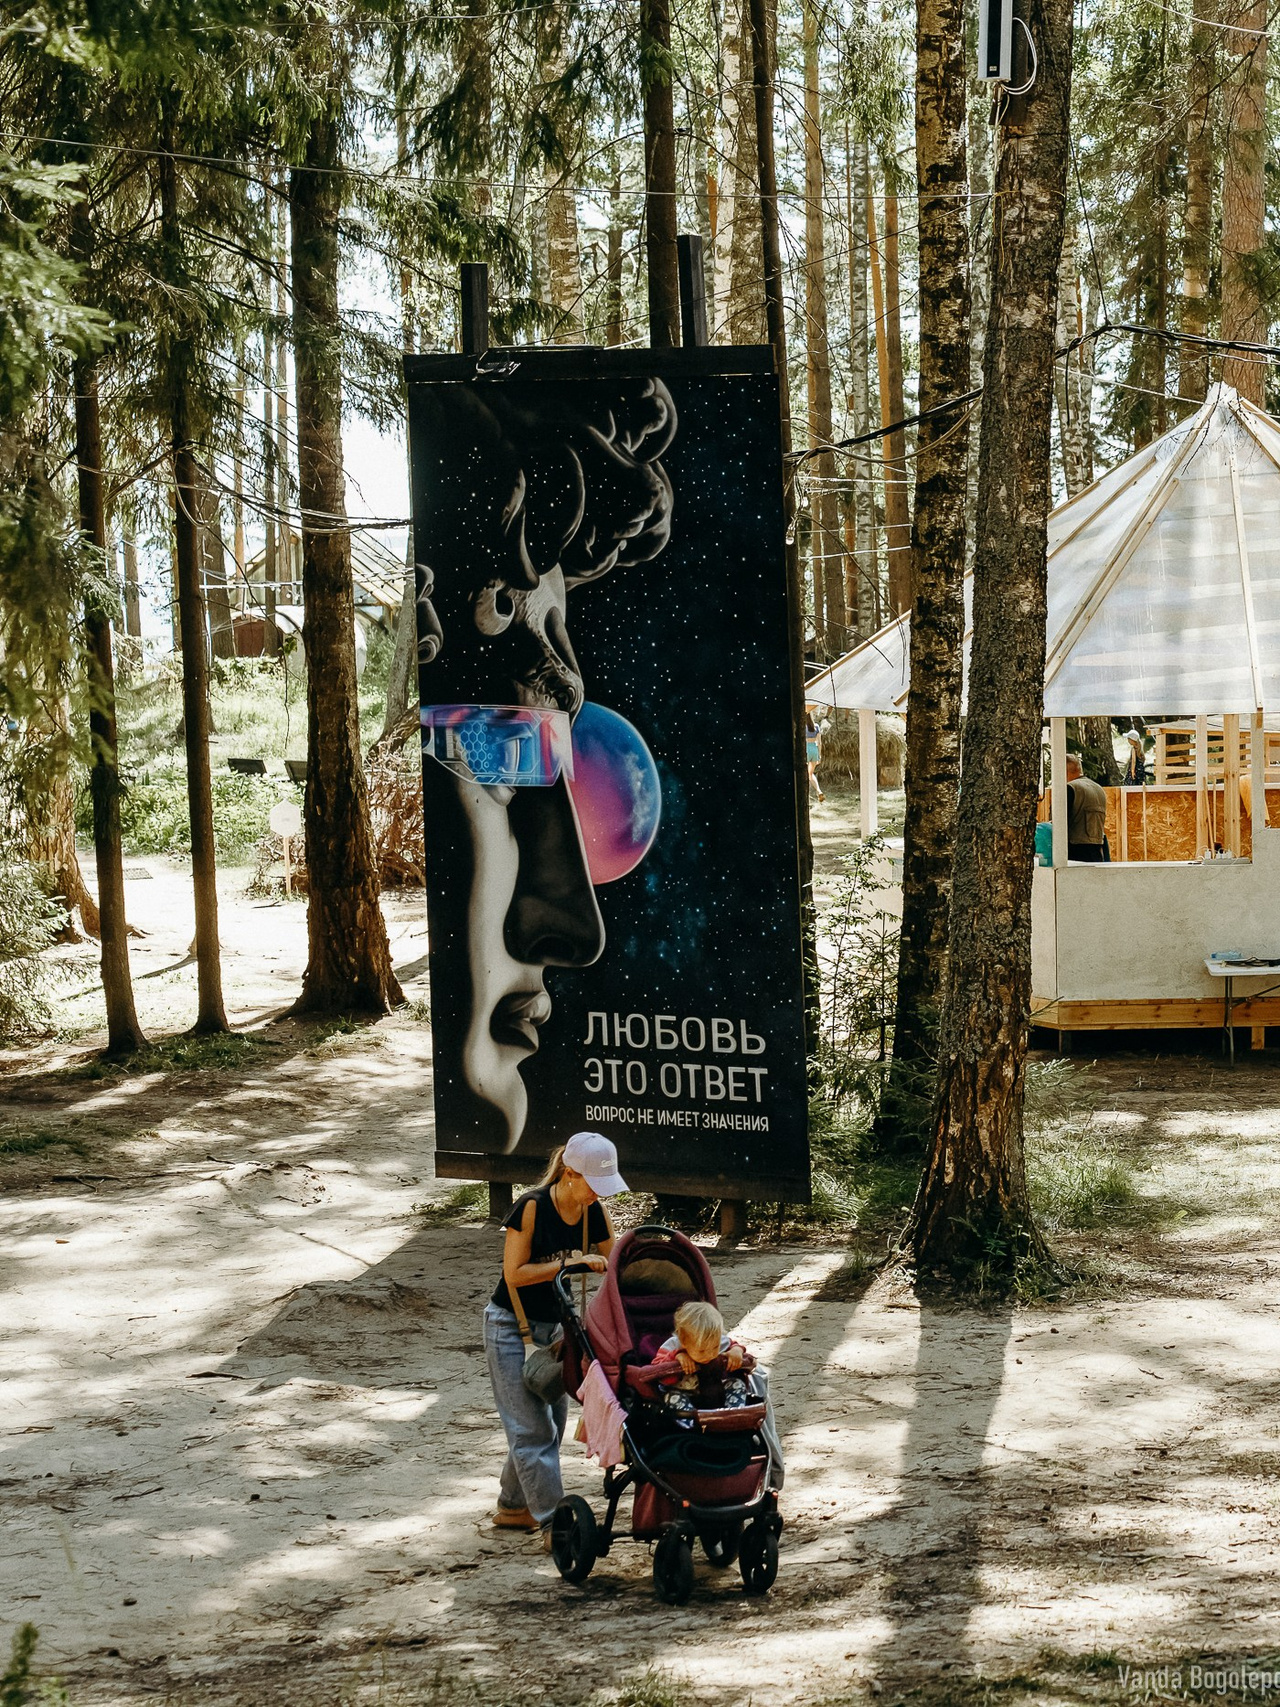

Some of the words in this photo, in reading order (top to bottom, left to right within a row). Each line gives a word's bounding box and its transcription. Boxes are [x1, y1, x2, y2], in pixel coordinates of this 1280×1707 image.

[583, 1011, 767, 1055] ЛЮБОВЬ
[583, 1057, 648, 1096] ЭТО
[660, 1062, 768, 1103] ОТВЕТ
[585, 1104, 635, 1124] ВОПРОС
[637, 1108, 654, 1125] НЕ
[657, 1109, 701, 1128] ИМЕЕТ
[702, 1112, 769, 1132] ЗНАЧЕНИЯ
